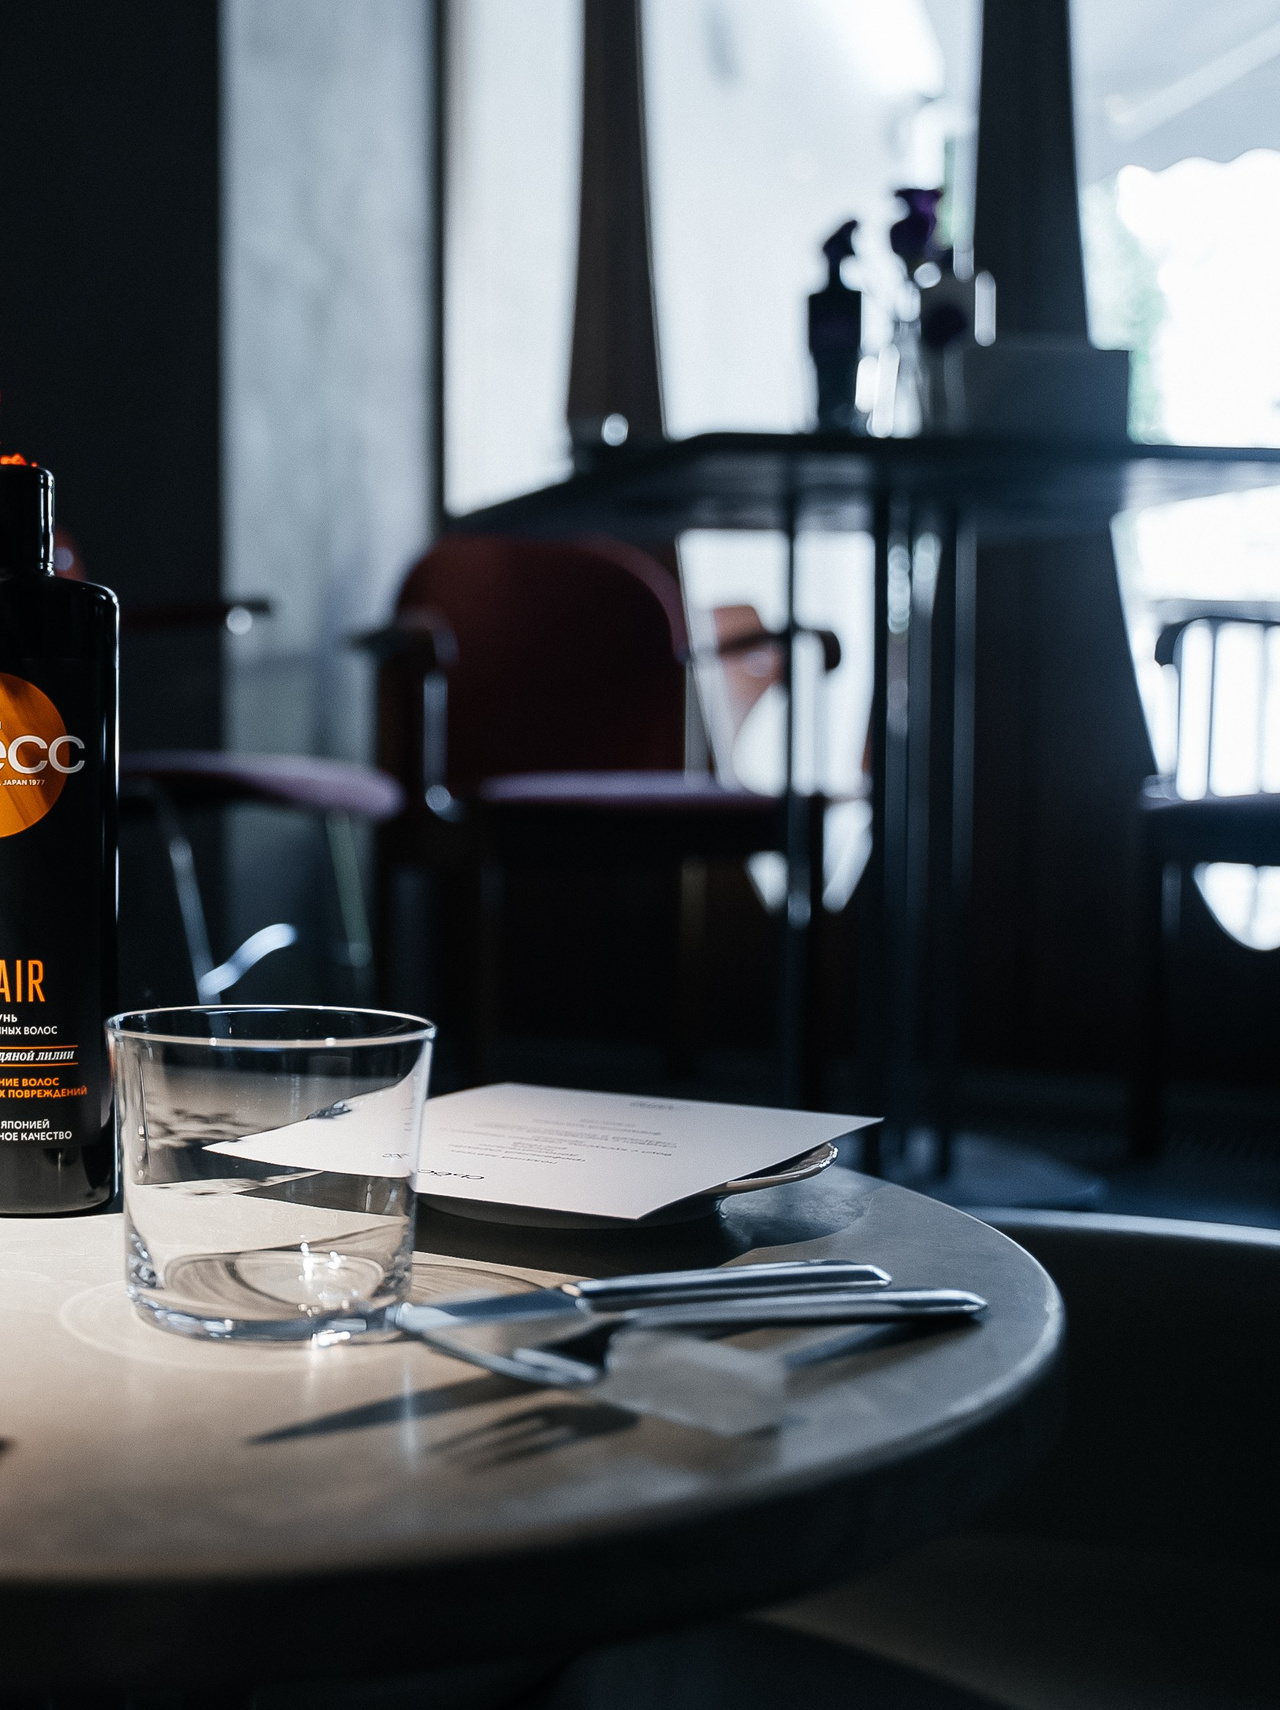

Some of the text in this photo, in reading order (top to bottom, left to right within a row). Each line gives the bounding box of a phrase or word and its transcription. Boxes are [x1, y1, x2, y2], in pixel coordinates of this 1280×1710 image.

[23, 1026, 58, 1035] ВОЛОС
[35, 1050, 75, 1061] ЛИЛИИ
[22, 1077, 60, 1087] ВОЛОС
[8, 1085, 88, 1098] ПОВРЕЖДЕНИЙ
[0, 1119, 50, 1130] ЯПОНИЕЙ
[20, 1130, 73, 1141] КАЧЕСТВО
